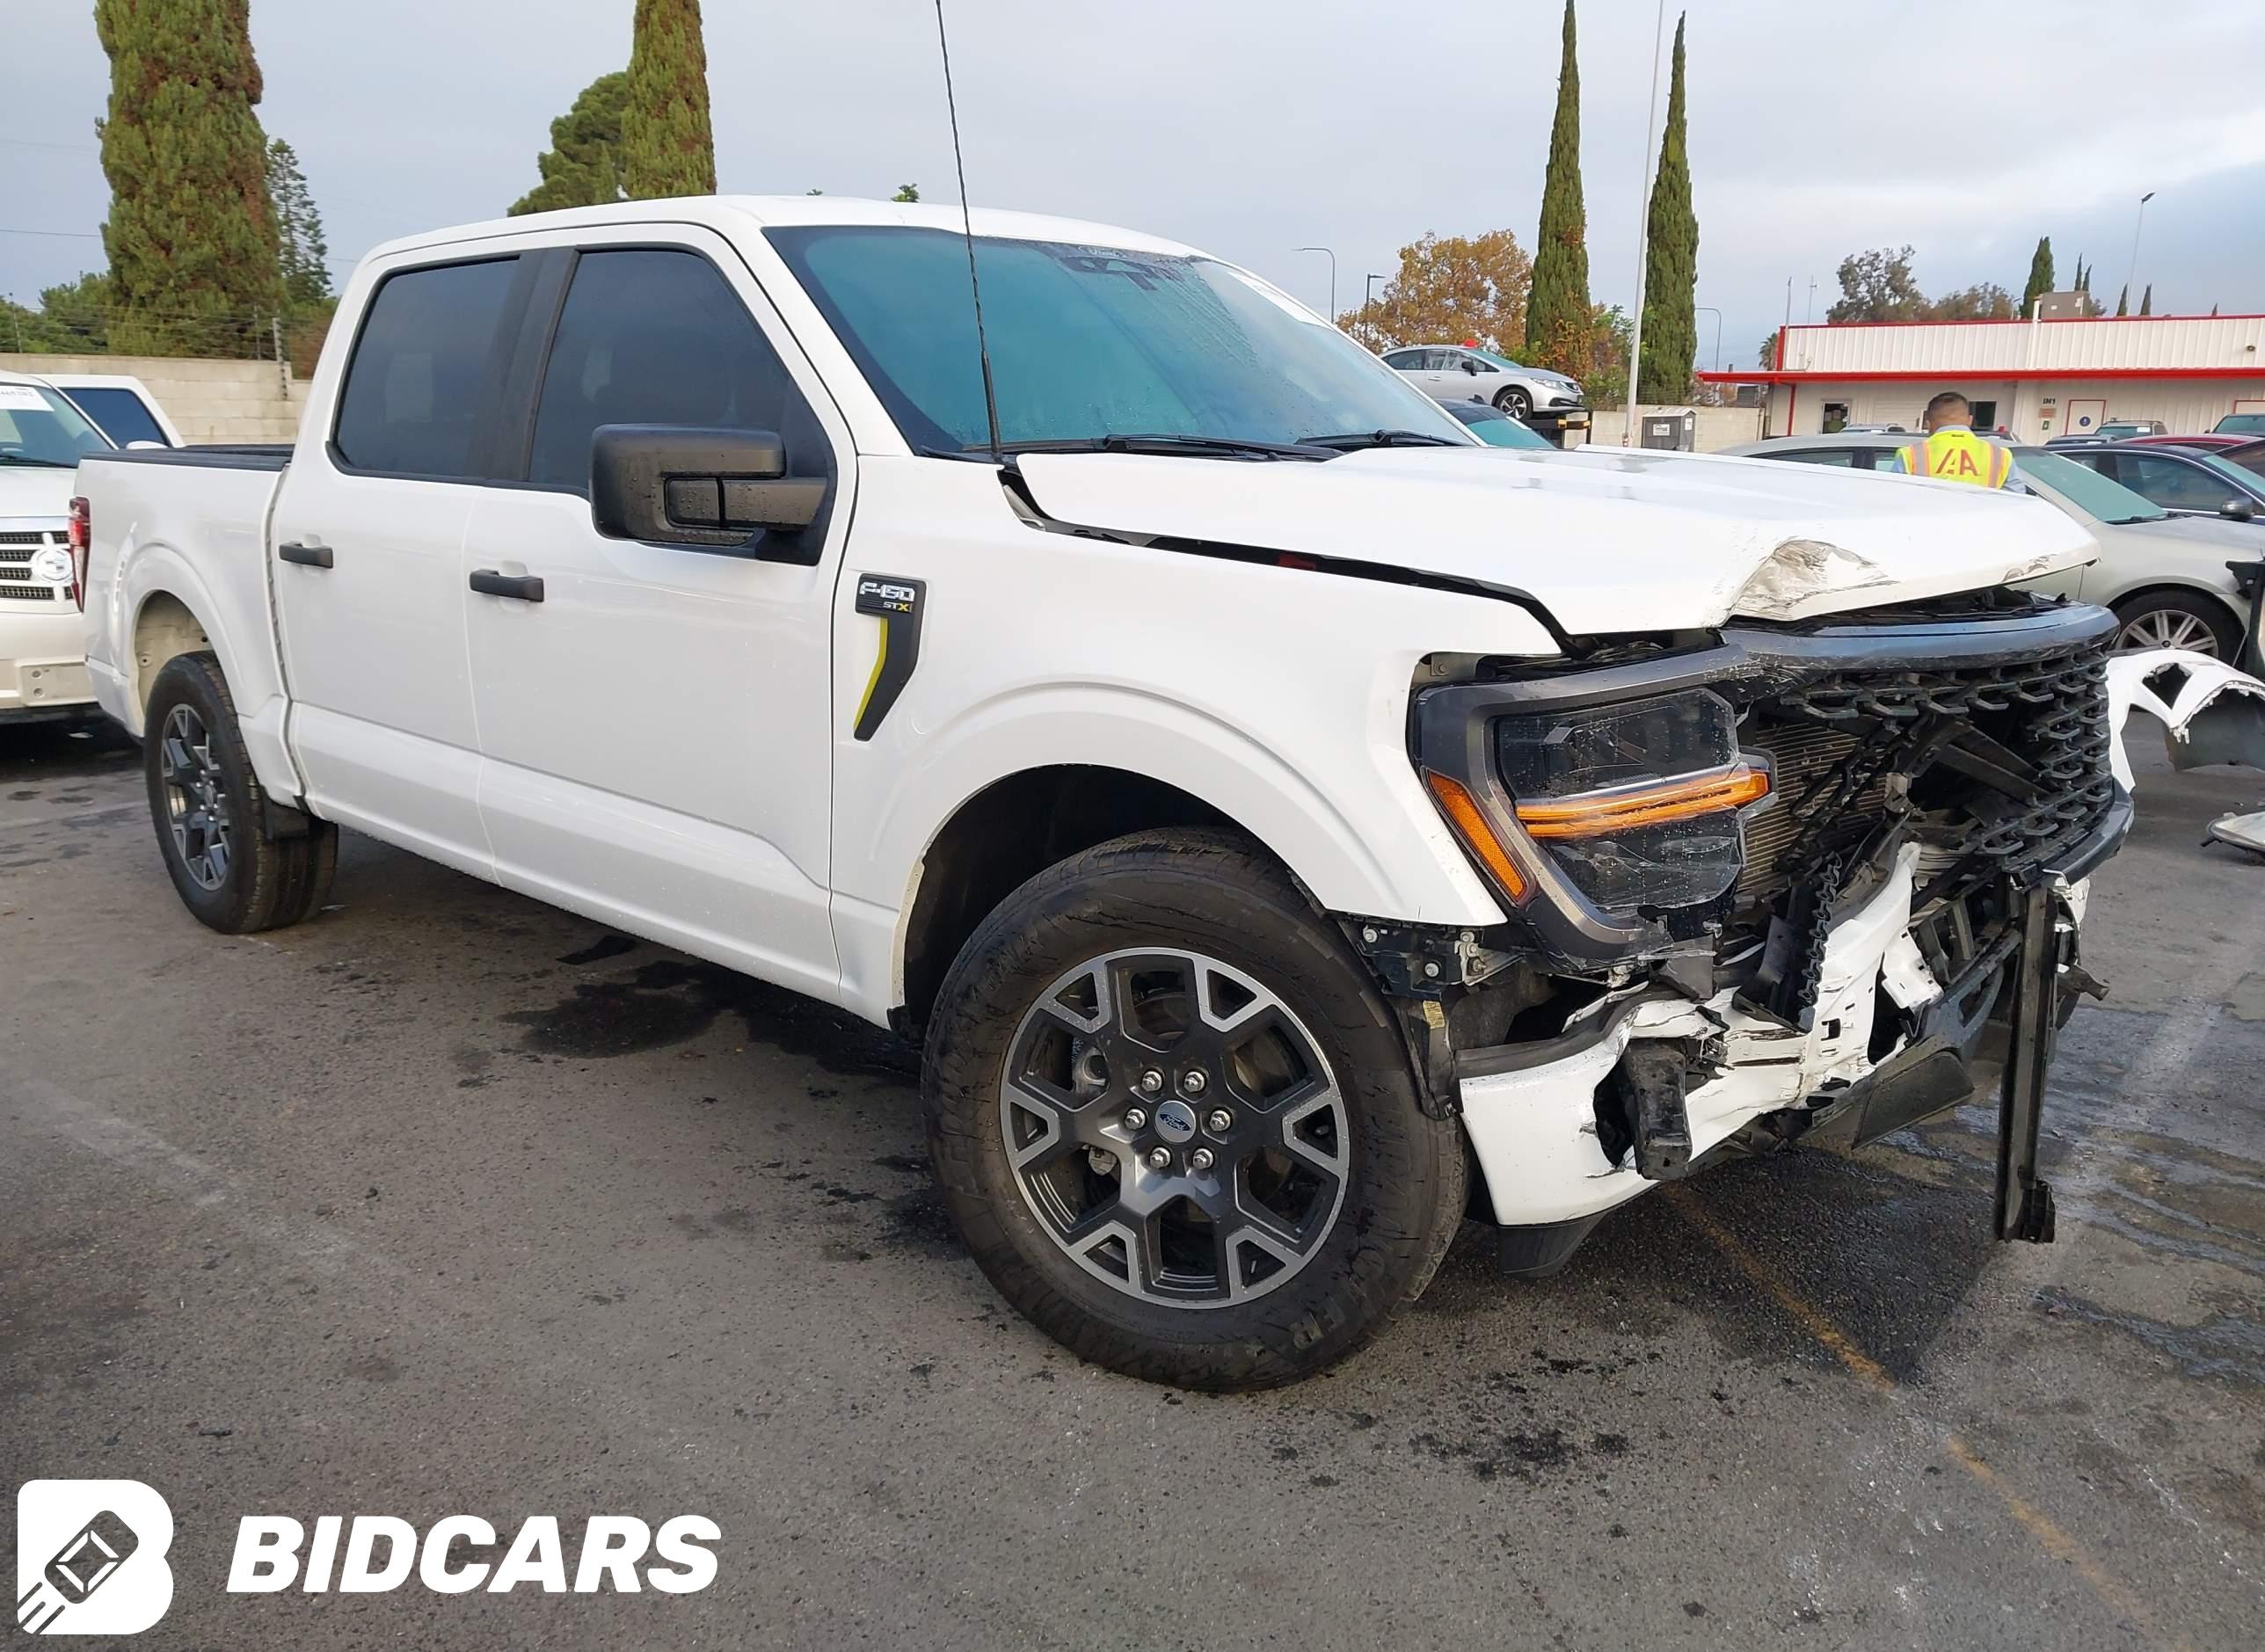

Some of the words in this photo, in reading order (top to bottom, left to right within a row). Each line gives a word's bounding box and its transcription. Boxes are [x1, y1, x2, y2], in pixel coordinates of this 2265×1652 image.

[859, 581, 915, 601] F-150
[883, 600, 910, 612] STX
[1162, 1115, 1188, 1131] Ford
